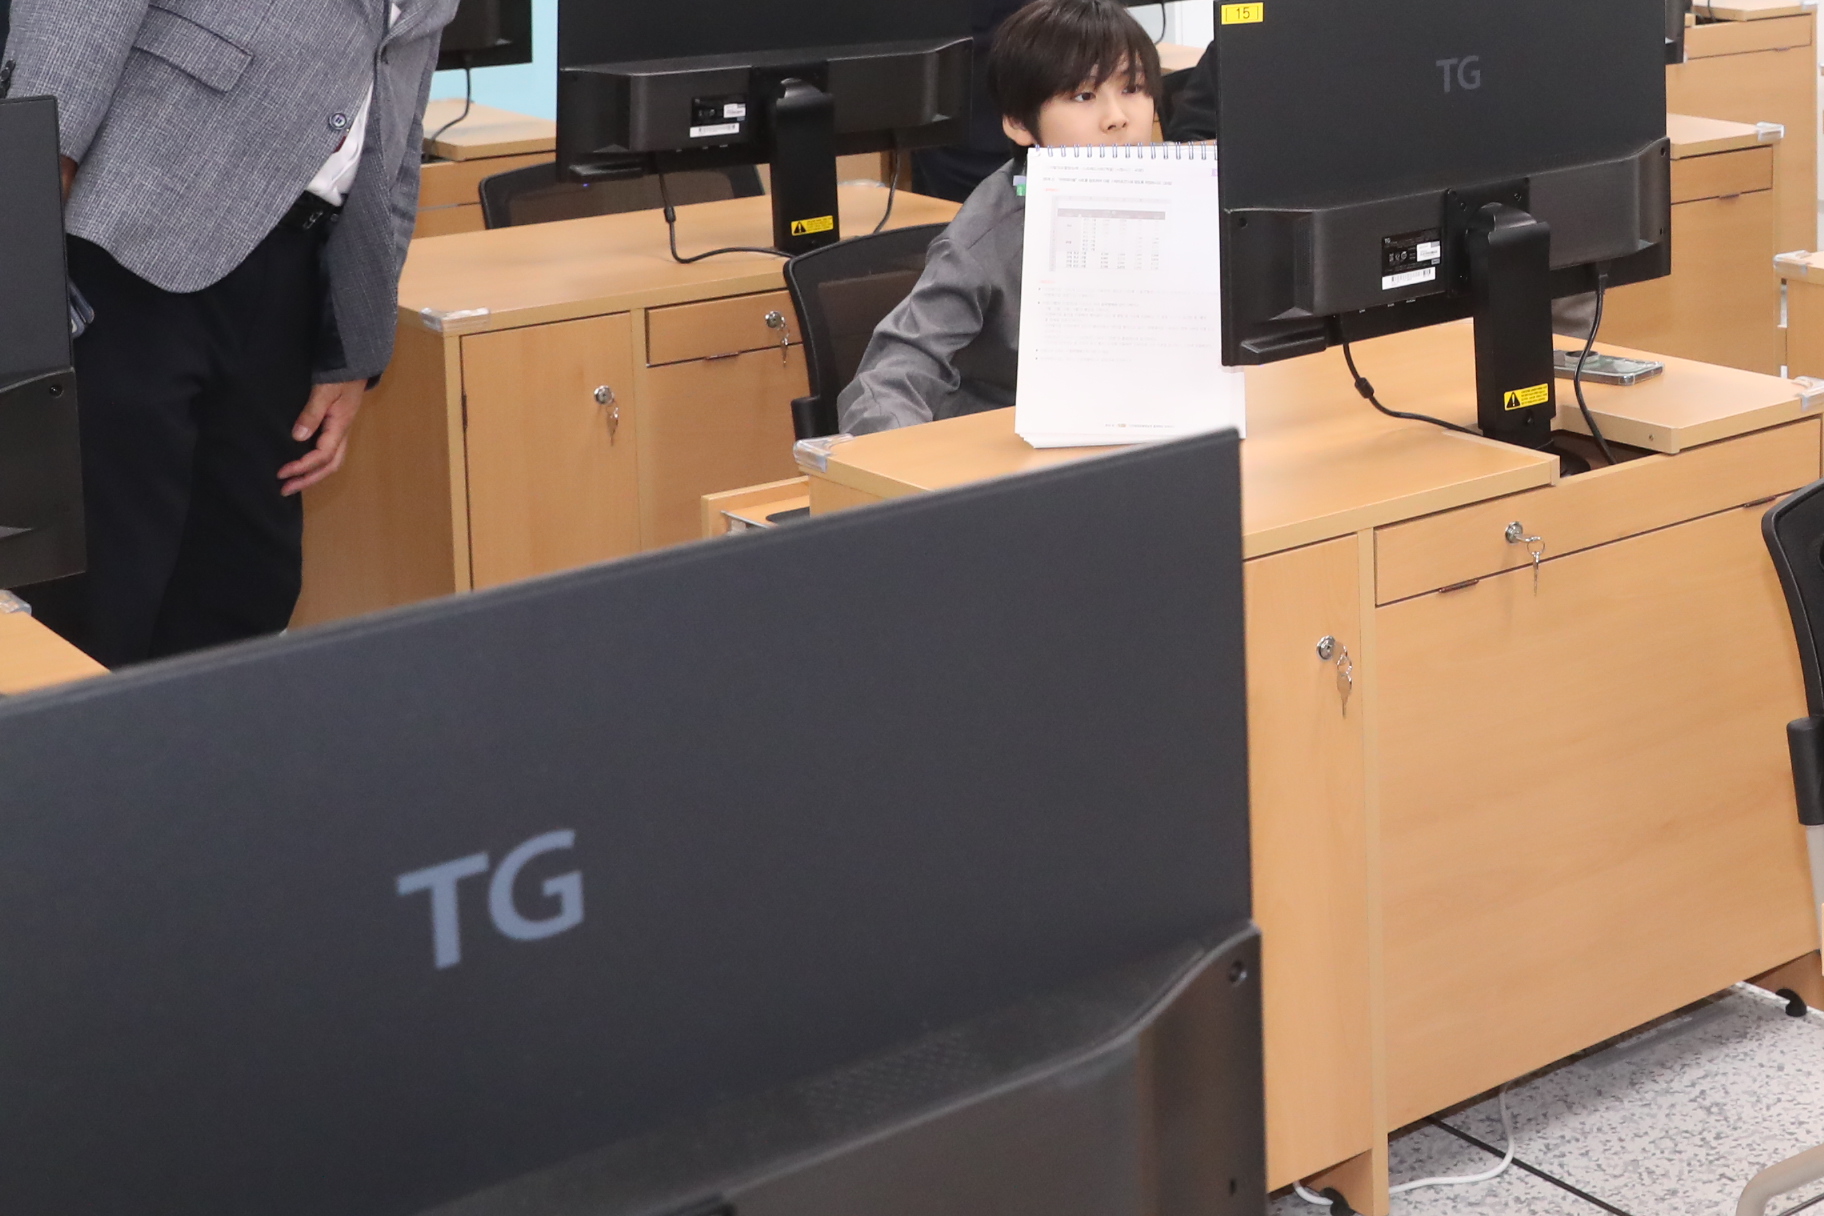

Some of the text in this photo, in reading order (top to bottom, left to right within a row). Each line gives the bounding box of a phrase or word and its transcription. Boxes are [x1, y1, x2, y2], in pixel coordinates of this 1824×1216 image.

[1236, 6, 1250, 19] 15
[1436, 55, 1481, 93] TG
[396, 828, 585, 971] TG
